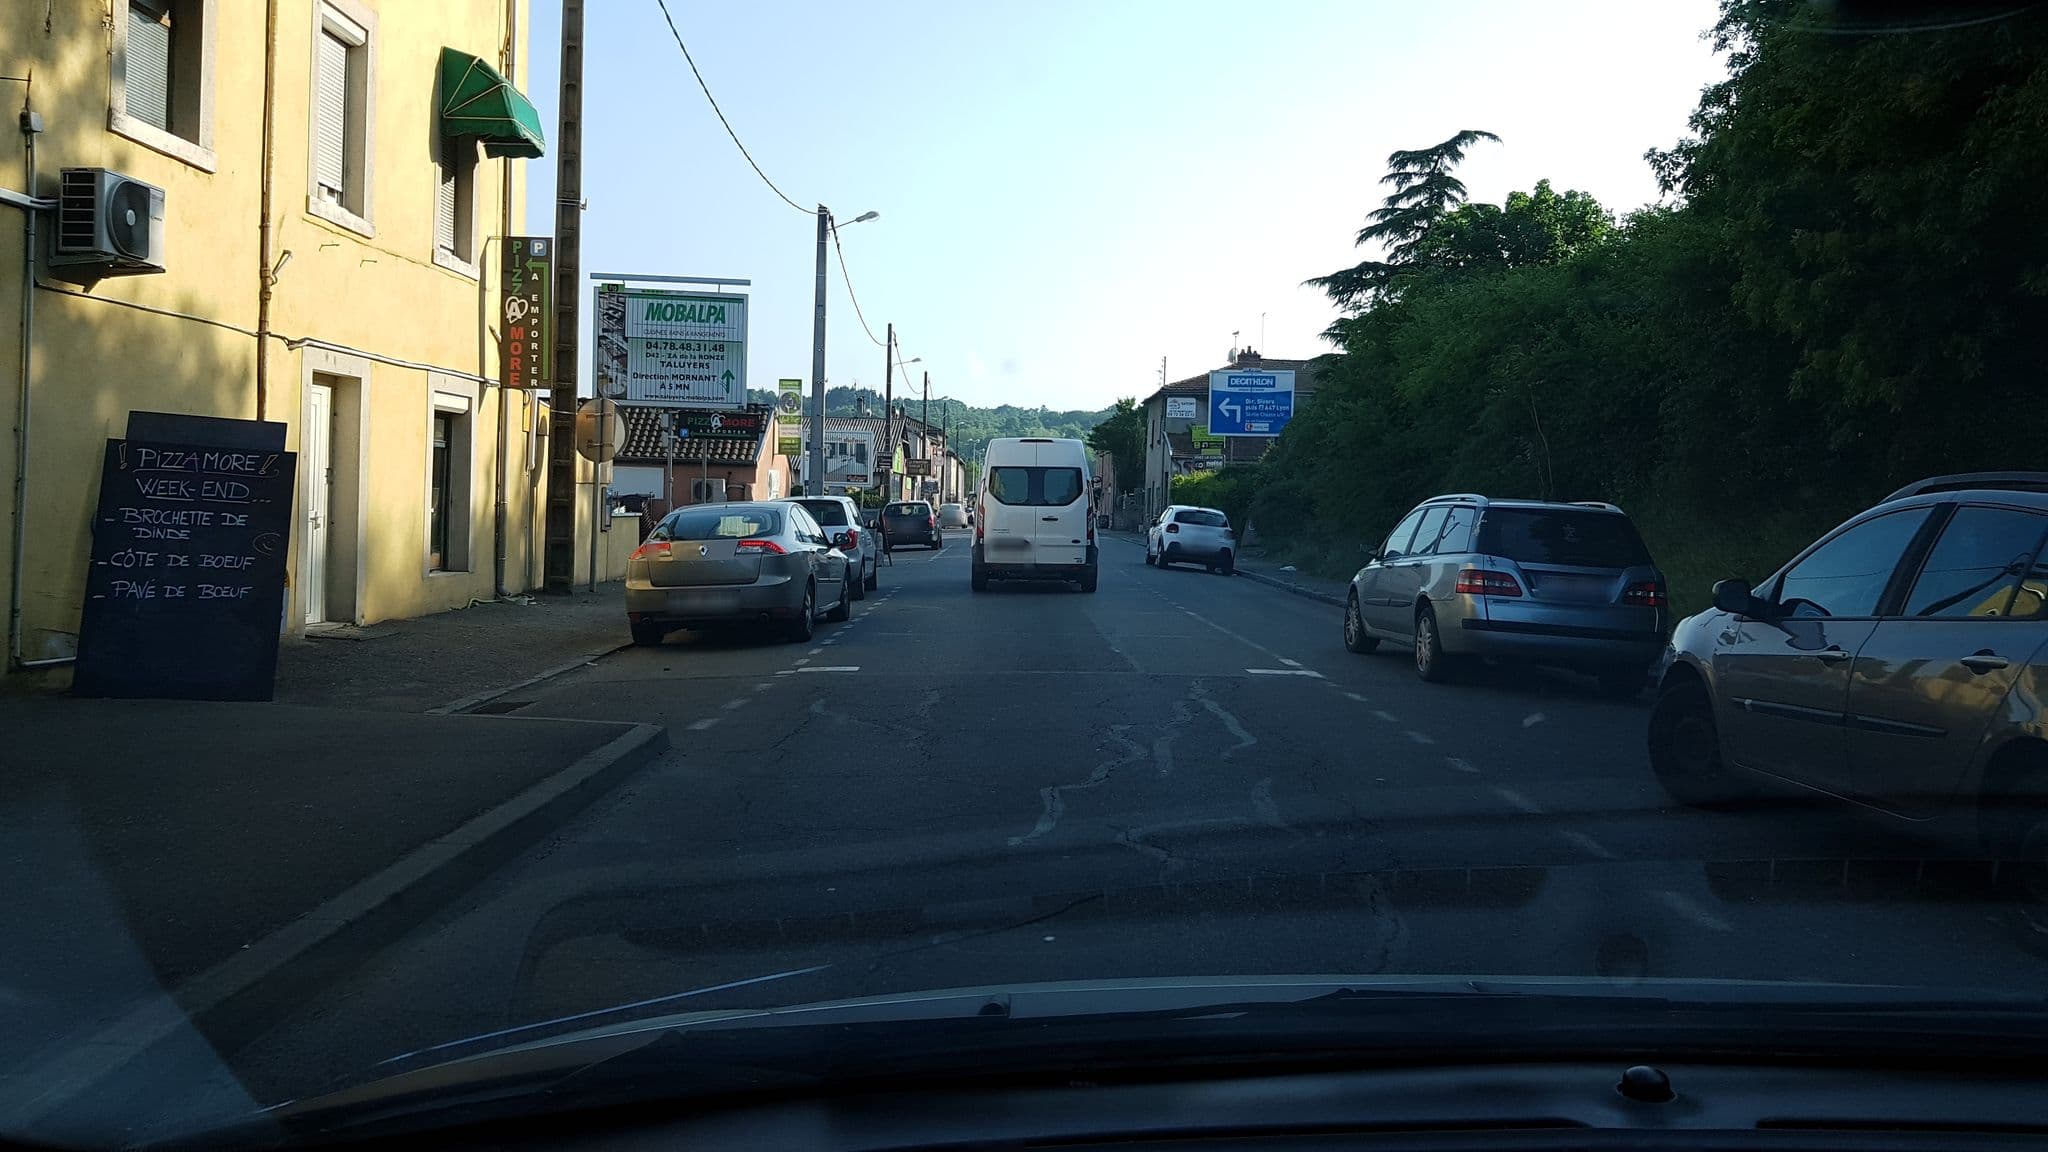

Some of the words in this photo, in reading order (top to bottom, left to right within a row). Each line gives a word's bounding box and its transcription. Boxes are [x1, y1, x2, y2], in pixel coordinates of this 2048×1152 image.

[645, 302, 726, 324] MOBALPA
[531, 294, 539, 386] EMPORTER
[645, 342, 725, 352] 04.78.48.31.48
[660, 361, 710, 369] TALUYERS
[633, 372, 669, 380] Direction
[671, 374, 717, 382] MORNANT
[1230, 378, 1273, 387] DECATHLON
[120, 507, 215, 526] BROCHETTE
[220, 513, 249, 526] DE
[110, 548, 159, 568] CÔTE
[167, 554, 190, 567] DE
[198, 554, 256, 571] BOEUF
[111, 578, 156, 599] PAVÉ
[164, 586, 186, 598] DE
[197, 584, 253, 599] BOEUF
